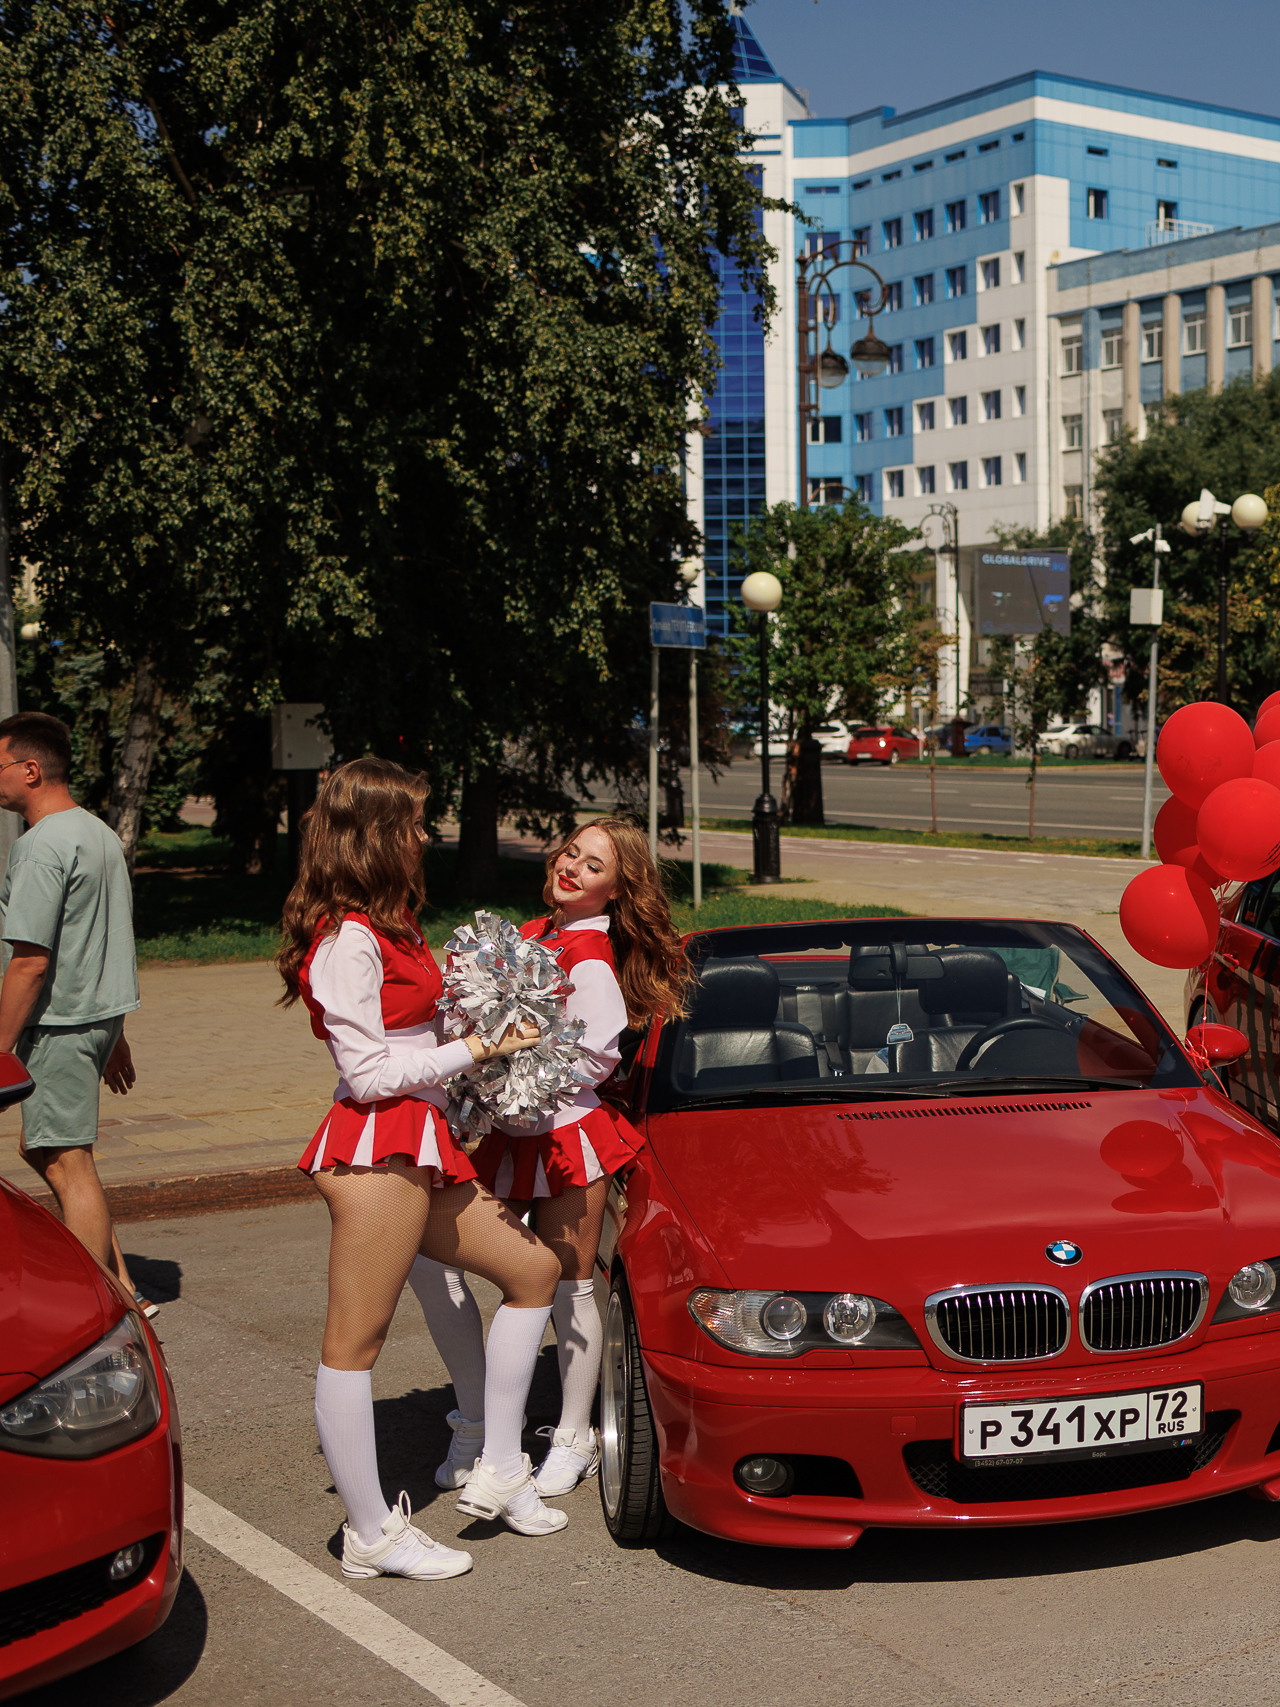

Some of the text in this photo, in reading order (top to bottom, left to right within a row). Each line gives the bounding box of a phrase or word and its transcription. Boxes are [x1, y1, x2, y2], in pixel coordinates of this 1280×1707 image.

[982, 554, 1051, 567] GLOBALDRIVE
[1152, 1390, 1188, 1422] 72
[1157, 1419, 1185, 1434] RUS
[995, 1458, 1024, 1466] 67-07-07
